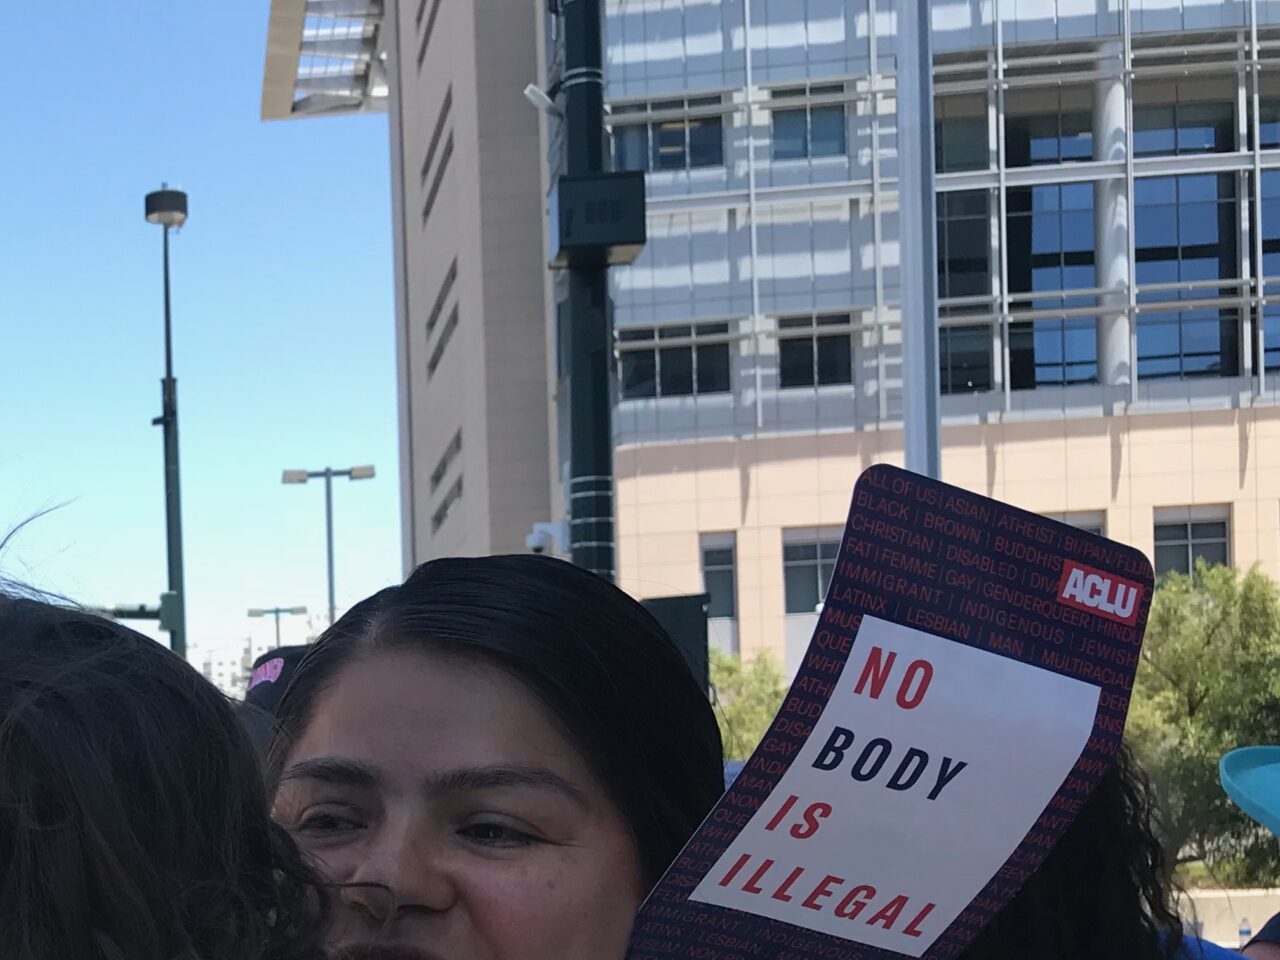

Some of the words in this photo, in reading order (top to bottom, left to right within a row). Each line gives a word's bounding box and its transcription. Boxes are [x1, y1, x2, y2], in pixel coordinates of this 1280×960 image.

[856, 491, 909, 521] BLACK
[923, 512, 982, 545] BROWN
[861, 470, 889, 490] ALL
[892, 478, 913, 496] OF
[916, 486, 936, 505] US
[944, 496, 991, 523] ASIAN
[998, 514, 1058, 545] ATHEIST
[851, 514, 934, 554] CHRISTIAN
[945, 544, 1018, 581] DISABLED
[840, 560, 943, 604] IMMIGRANT
[959, 600, 1065, 645] INDIGENOUS
[1079, 637, 1137, 669] JEWISH
[846, 537, 874, 559] FAT
[881, 548, 938, 580] FEMME
[945, 569, 976, 591] GAY
[983, 581, 1090, 627] GENDERQUEER
[1095, 620, 1143, 647] HINDU
[1062, 568, 1137, 618] ACLU
[832, 584, 888, 612] LATINX
[907, 606, 970, 639] LESBIAN
[989, 632, 1025, 655] MAN
[1041, 651, 1131, 691] MULTIRACIAL
[853, 645, 934, 710] NO
[811, 726, 968, 801] BODY
[764, 794, 833, 839] IS
[718, 853, 937, 938] ILLEGAL
